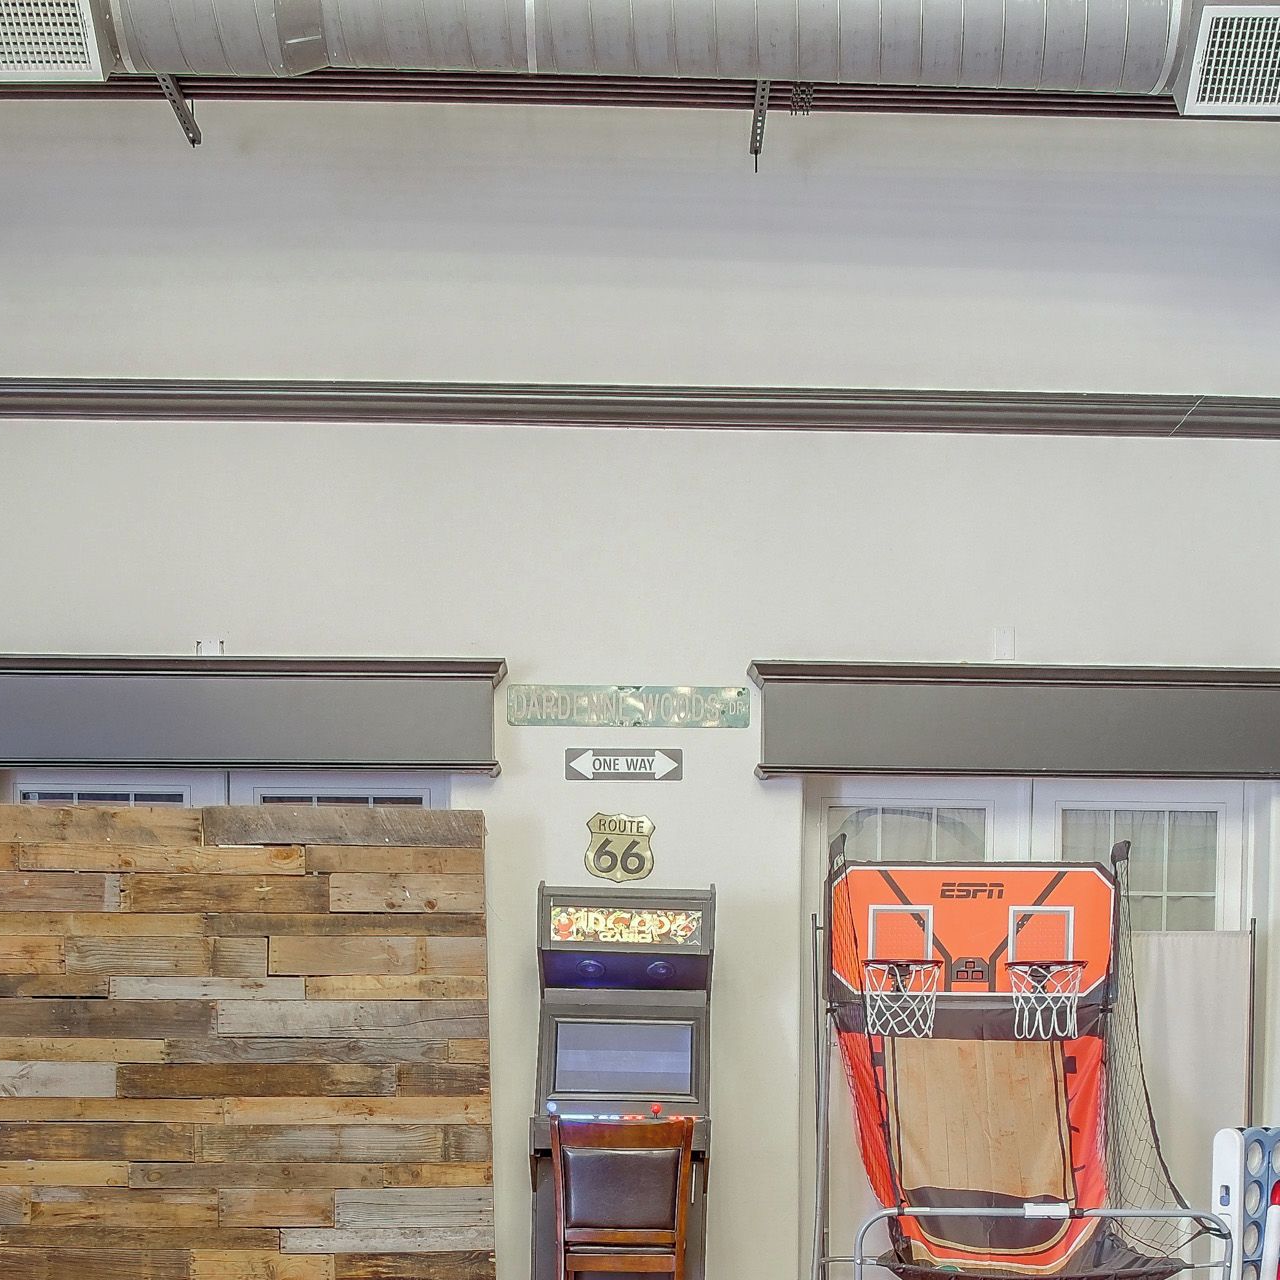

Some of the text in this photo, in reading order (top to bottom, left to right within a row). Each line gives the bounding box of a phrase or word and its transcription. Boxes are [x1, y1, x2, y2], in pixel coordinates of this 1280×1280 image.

[513, 690, 631, 722] DARDENNE
[641, 692, 721, 722] WOODS
[592, 757, 655, 772] ONE WAY
[598, 818, 645, 834] ROUTE
[593, 837, 646, 875] 66
[940, 882, 1005, 899] ESPN
